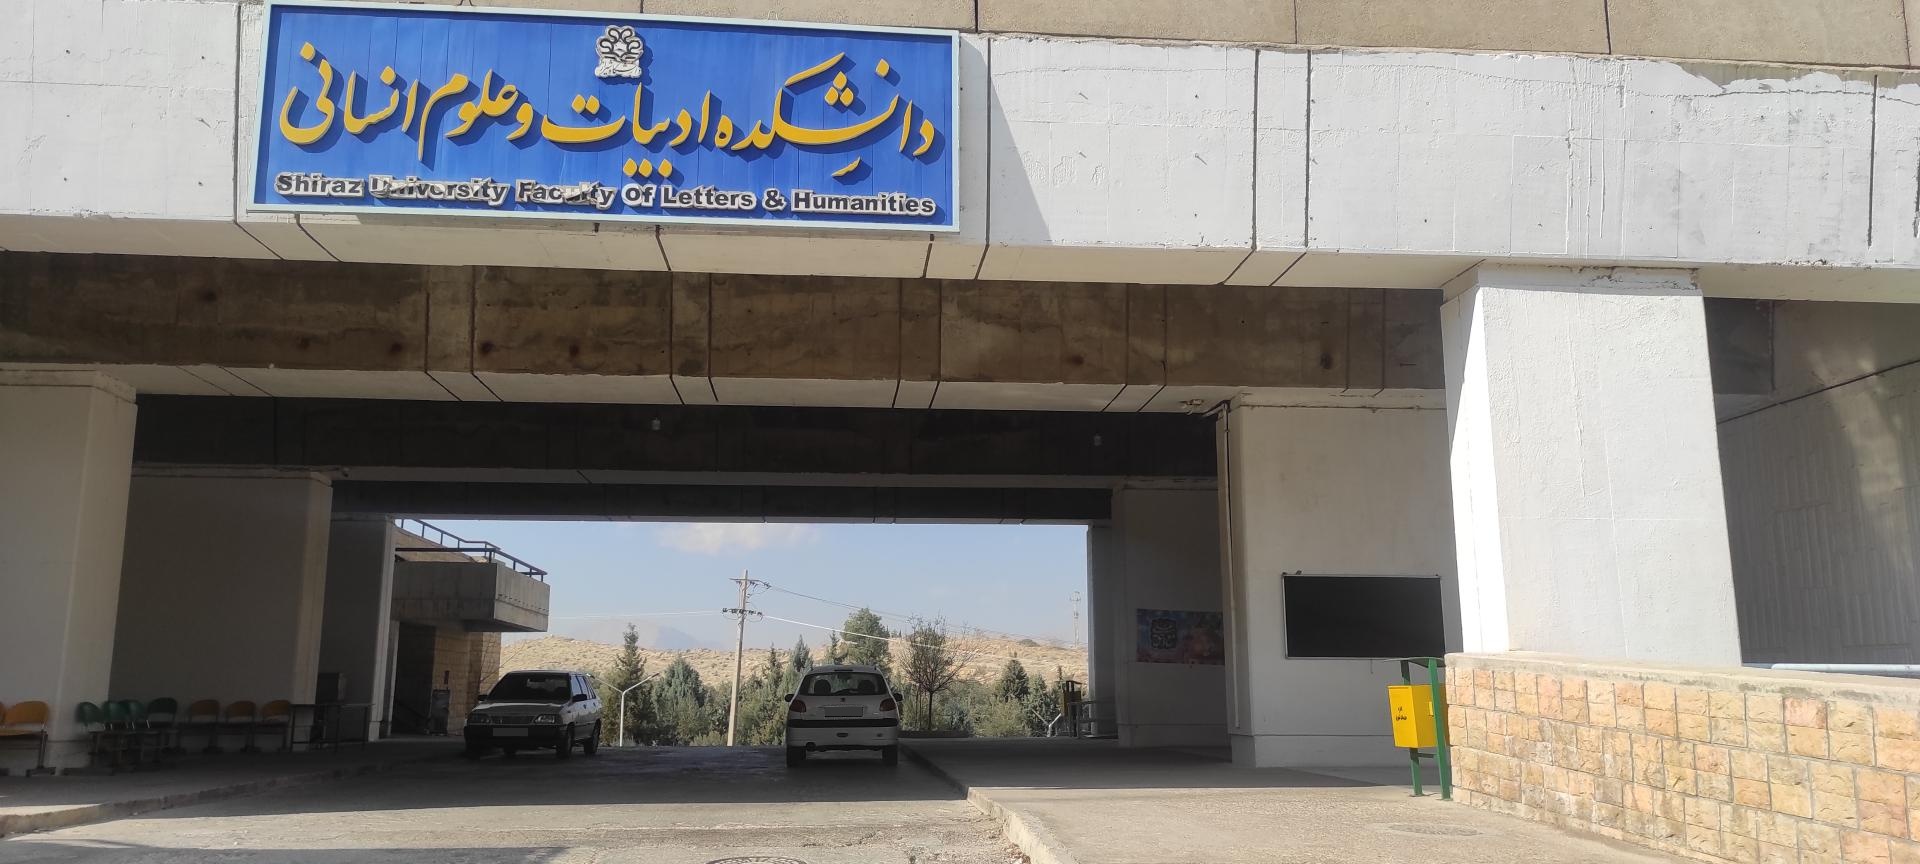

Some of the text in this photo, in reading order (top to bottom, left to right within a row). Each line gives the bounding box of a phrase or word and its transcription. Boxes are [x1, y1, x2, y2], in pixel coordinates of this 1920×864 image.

[279, 42, 419, 145] انسانی
[540, 82, 711, 178] ادبیات
[274, 173, 362, 195] Shiraz
[623, 185, 654, 205] Of
[662, 187, 754, 208] Letters
[762, 188, 784, 210] &
[792, 190, 936, 214] Humanities
